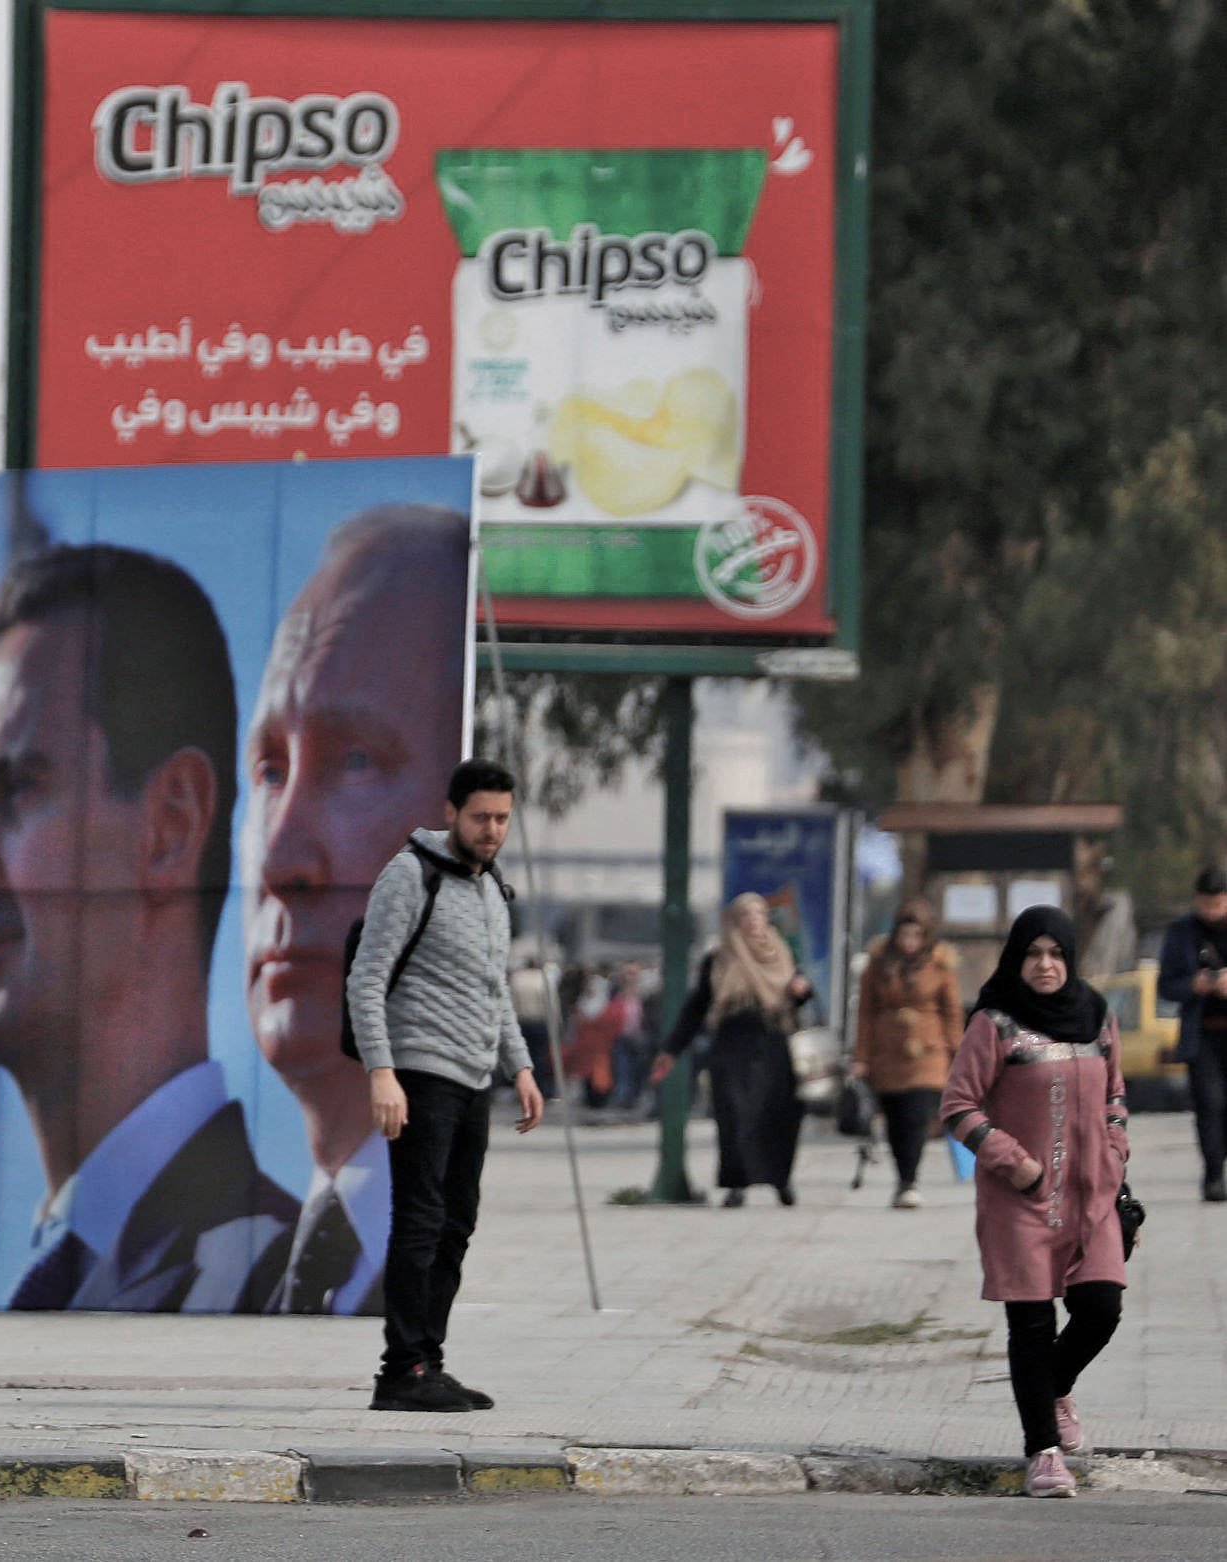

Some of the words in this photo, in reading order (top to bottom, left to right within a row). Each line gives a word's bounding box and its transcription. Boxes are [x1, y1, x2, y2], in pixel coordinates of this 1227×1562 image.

[93, 82, 400, 196] Chipso
[484, 224, 714, 308] Chipso
[83, 316, 192, 369] أطيب
[196, 322, 272, 379] وفي
[276, 328, 373, 371] طيب
[377, 324, 430, 381] في
[111, 388, 187, 444] وفي
[188, 387, 320, 437] شيبس
[324, 391, 401, 446] وفي
